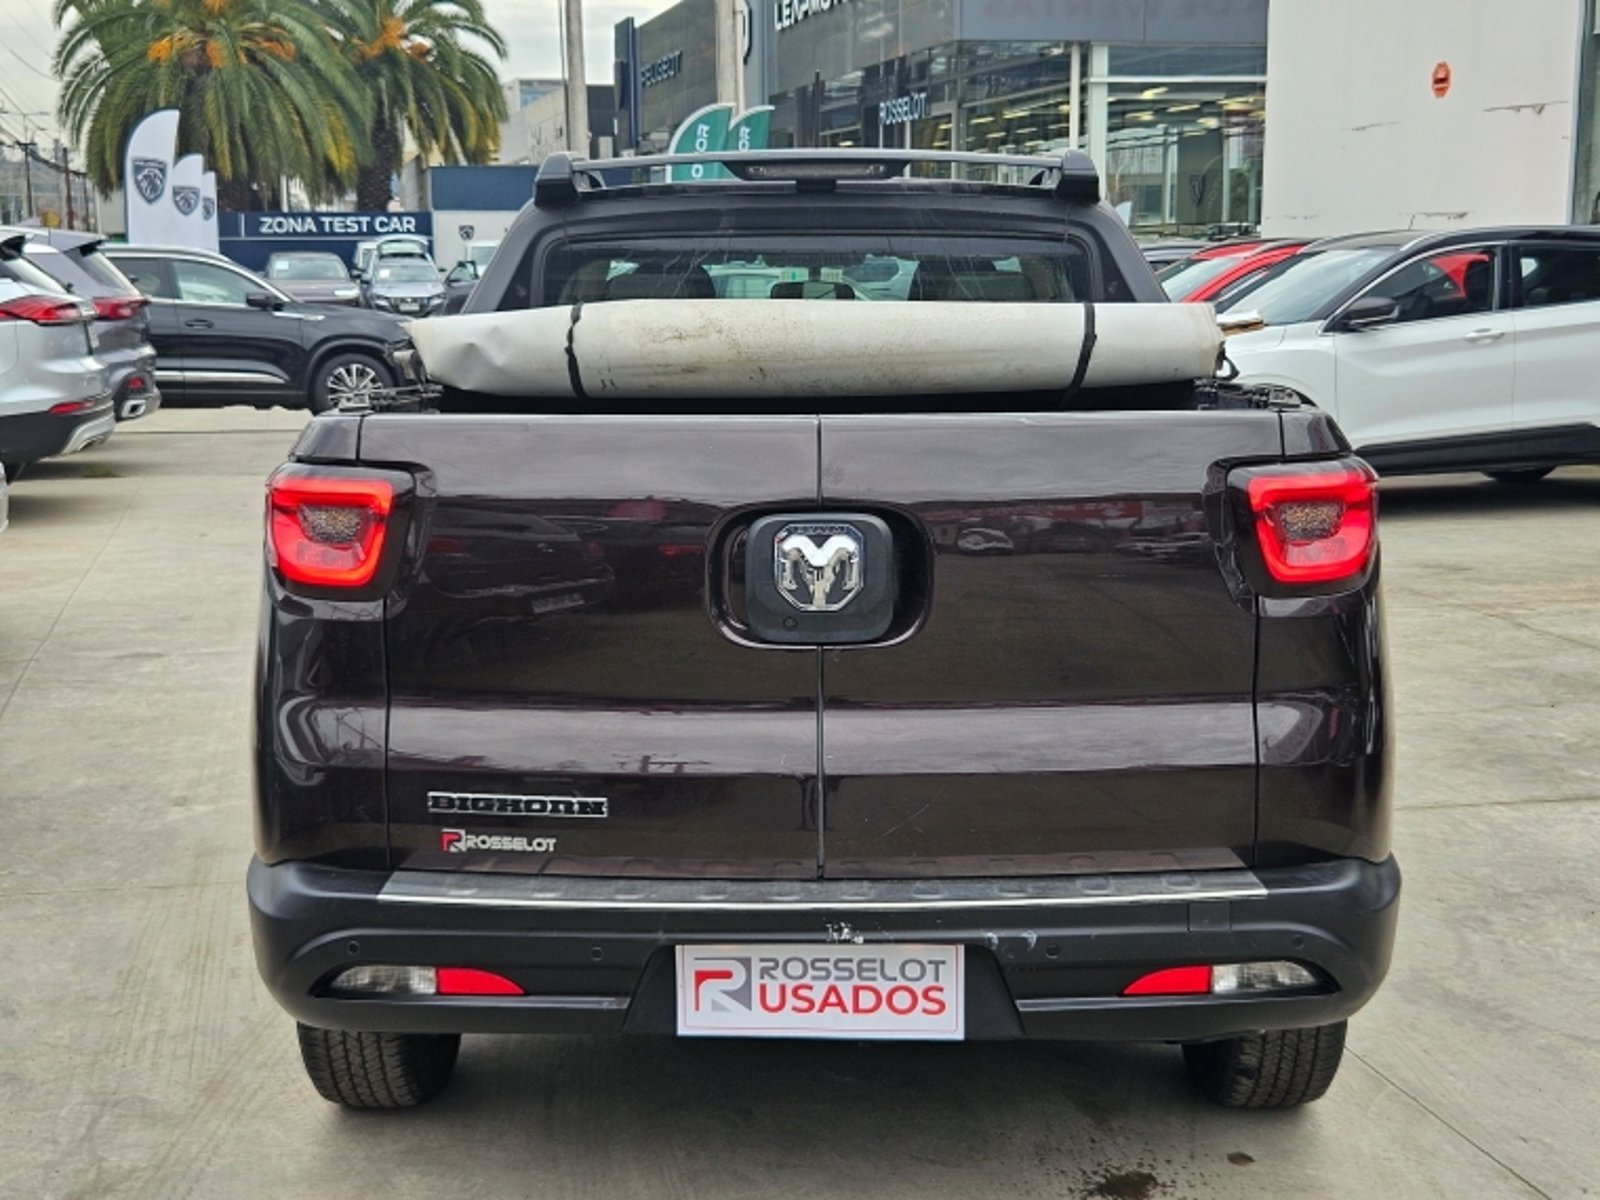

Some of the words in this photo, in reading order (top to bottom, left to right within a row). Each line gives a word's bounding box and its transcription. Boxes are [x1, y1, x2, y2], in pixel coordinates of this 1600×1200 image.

[879, 92, 927, 125] ROSSELOT
[259, 216, 317, 234] ZONA
[320, 216, 371, 233] TEST
[374, 216, 416, 233] CAR
[427, 790, 608, 818] BIGHORN
[466, 834, 557, 852] ROSSELOT
[758, 956, 947, 982] ROSSELOT
[758, 983, 947, 1015] USADOS
